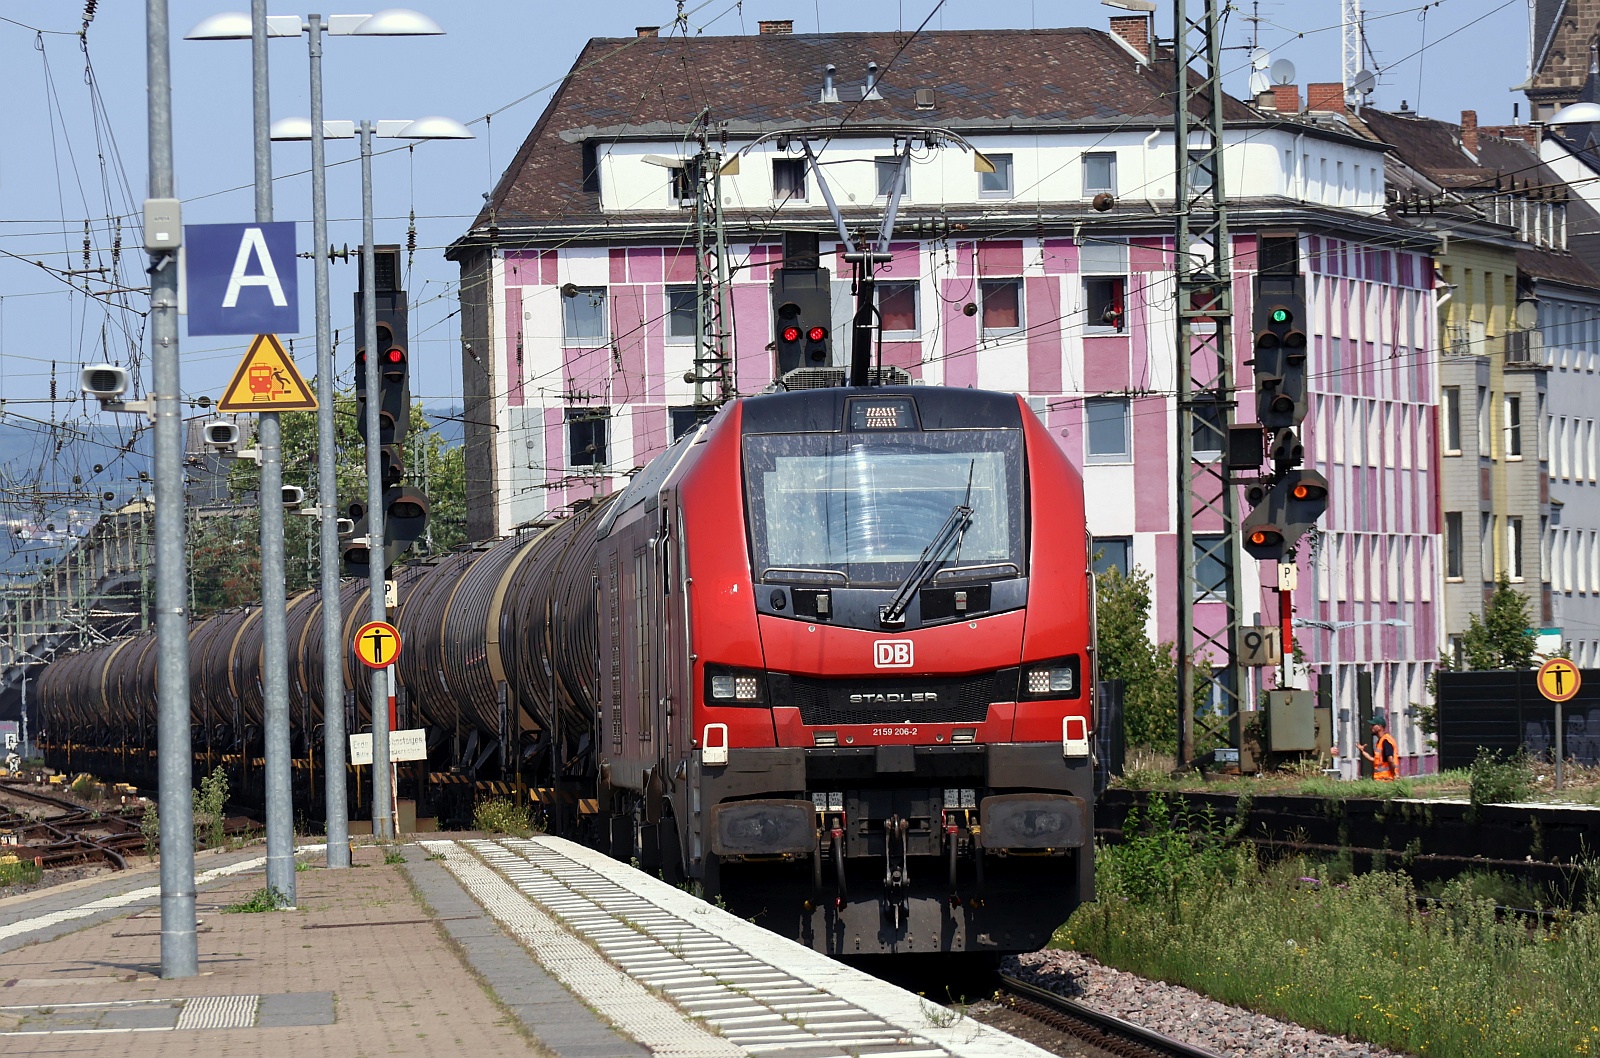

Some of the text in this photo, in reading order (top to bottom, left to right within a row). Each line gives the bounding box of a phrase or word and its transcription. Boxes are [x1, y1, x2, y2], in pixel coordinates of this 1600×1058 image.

[222, 227, 288, 307] A
[1284, 567, 1291, 578] P
[385, 584, 391, 595] P
[1244, 632, 1274, 660] 91
[878, 644, 909, 664] DB
[849, 692, 938, 704] STADLER
[872, 727, 918, 736] 2159 206-2
